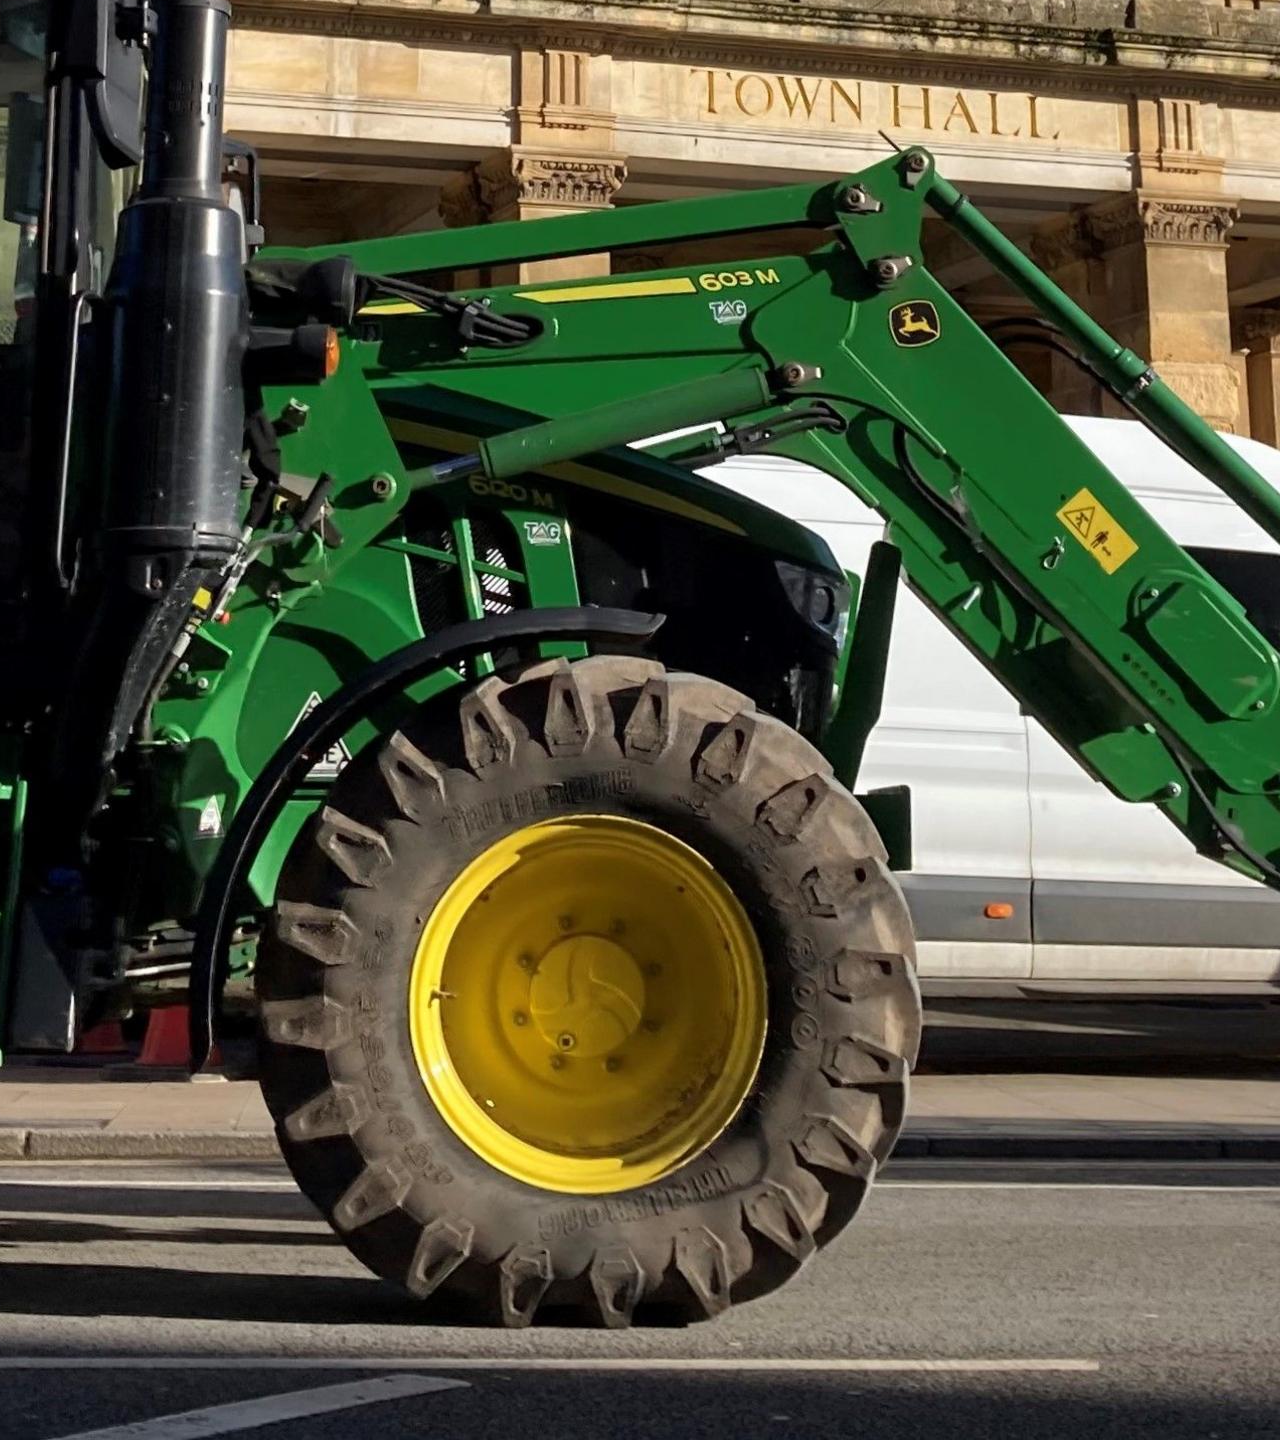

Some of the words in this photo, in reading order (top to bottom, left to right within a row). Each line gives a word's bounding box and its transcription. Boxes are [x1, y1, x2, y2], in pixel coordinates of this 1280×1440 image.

[689, 68, 863, 123] TOWN
[889, 83, 1061, 140] HALL
[698, 271, 754, 292] 603
[754, 268, 781, 285] M
[710, 300, 747, 319] TAG
[530, 488, 554, 510] M
[524, 523, 560, 540] TAG
